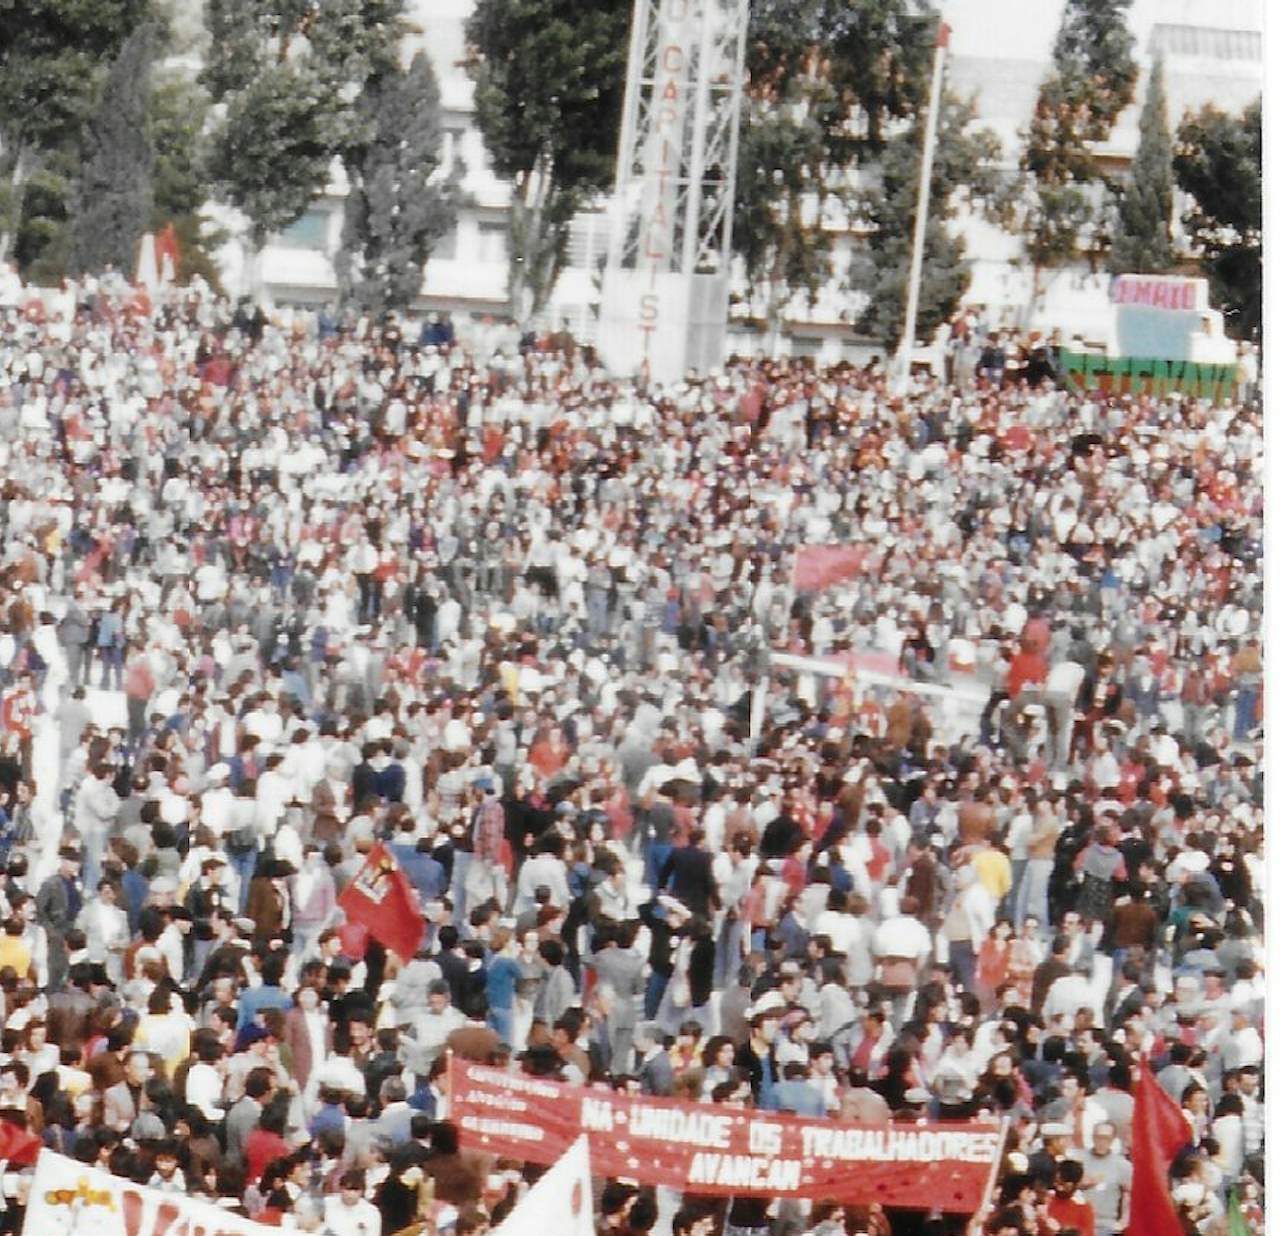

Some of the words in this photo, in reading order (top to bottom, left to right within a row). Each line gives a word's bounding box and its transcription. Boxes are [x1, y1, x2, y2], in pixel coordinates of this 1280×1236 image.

[581, 1098, 613, 1132] NA
[628, 1106, 731, 1149] UNIDADE
[749, 1121, 782, 1154] OS
[801, 1126, 1000, 1163] TRABALHADORES
